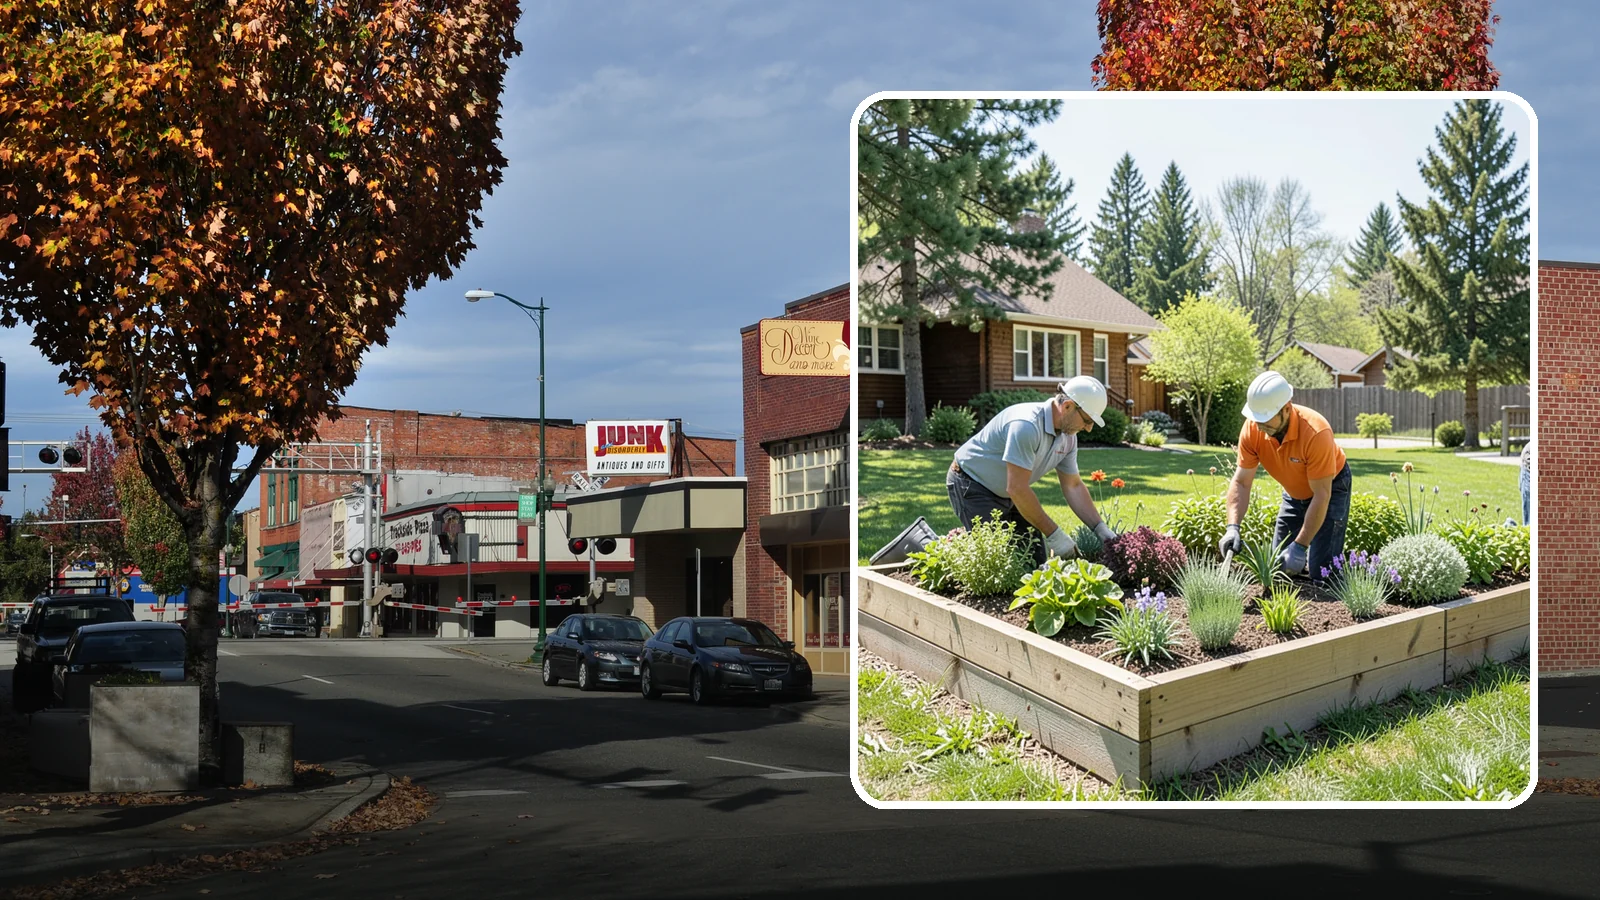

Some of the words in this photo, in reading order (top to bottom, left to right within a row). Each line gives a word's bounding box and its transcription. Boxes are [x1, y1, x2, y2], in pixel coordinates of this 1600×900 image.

[765, 327, 831, 365] Decor
[596, 425, 665, 457] JUNK
[607, 446, 646, 454] DISORDERLY
[597, 461, 628, 470] ANTIQUES
[631, 461, 644, 470] AND
[647, 461, 665, 469] GIFTS
[415, 519, 429, 535] Pizza
